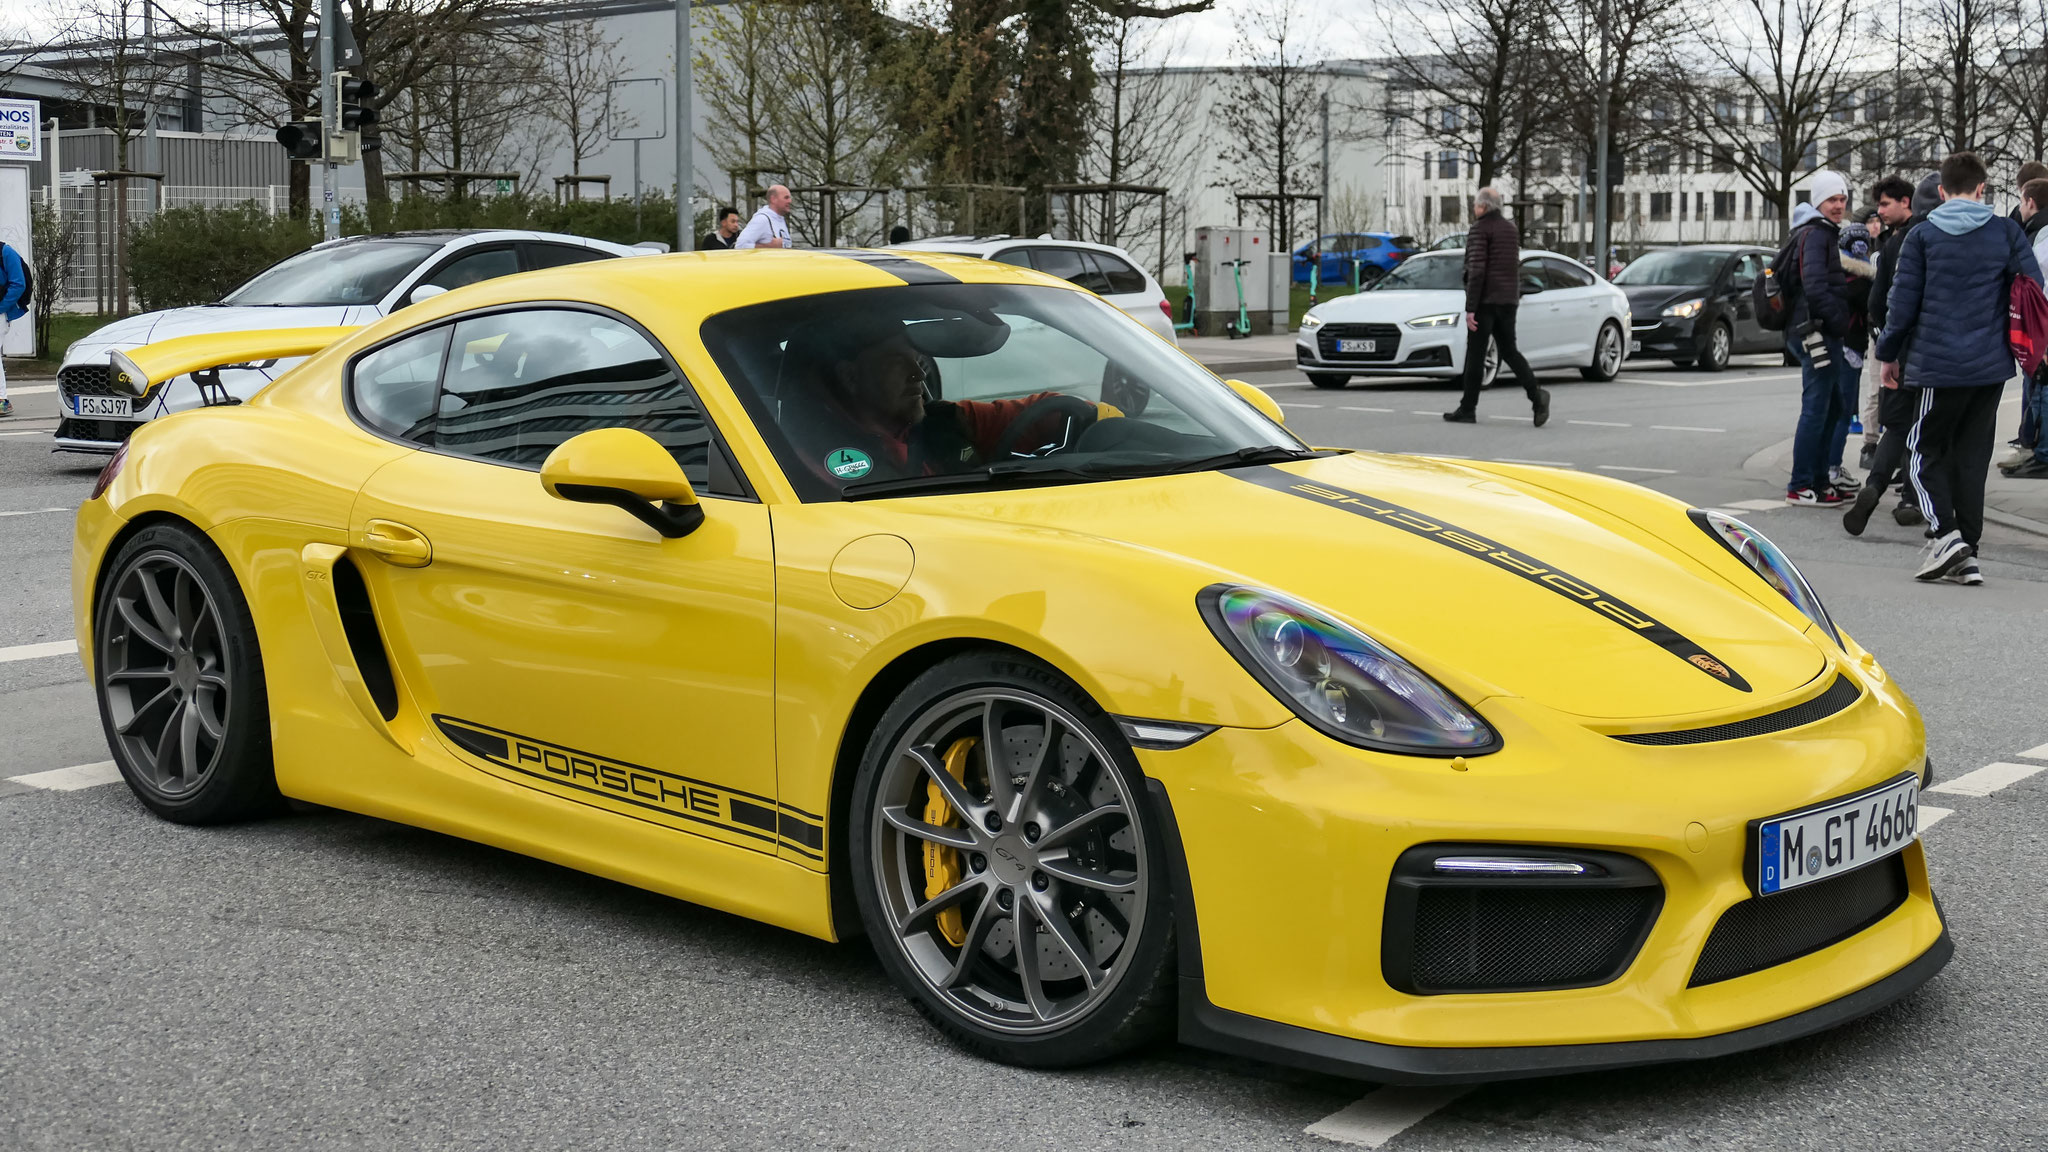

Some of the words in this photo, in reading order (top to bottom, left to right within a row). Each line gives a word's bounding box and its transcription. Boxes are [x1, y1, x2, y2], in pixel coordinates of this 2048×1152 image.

[0, 110, 30, 122] NOS
[82, 398, 95, 413] FS
[841, 450, 853, 463] 4
[1289, 483, 1656, 630] PORSCHE
[305, 570, 328, 581] GT4
[515, 742, 721, 818] PORSCHE
[1766, 866, 1775, 881] D
[1783, 825, 1804, 880] M
[1825, 809, 1860, 867] GT
[1865, 788, 1916, 852] 4666
[995, 847, 1027, 871] GT4
